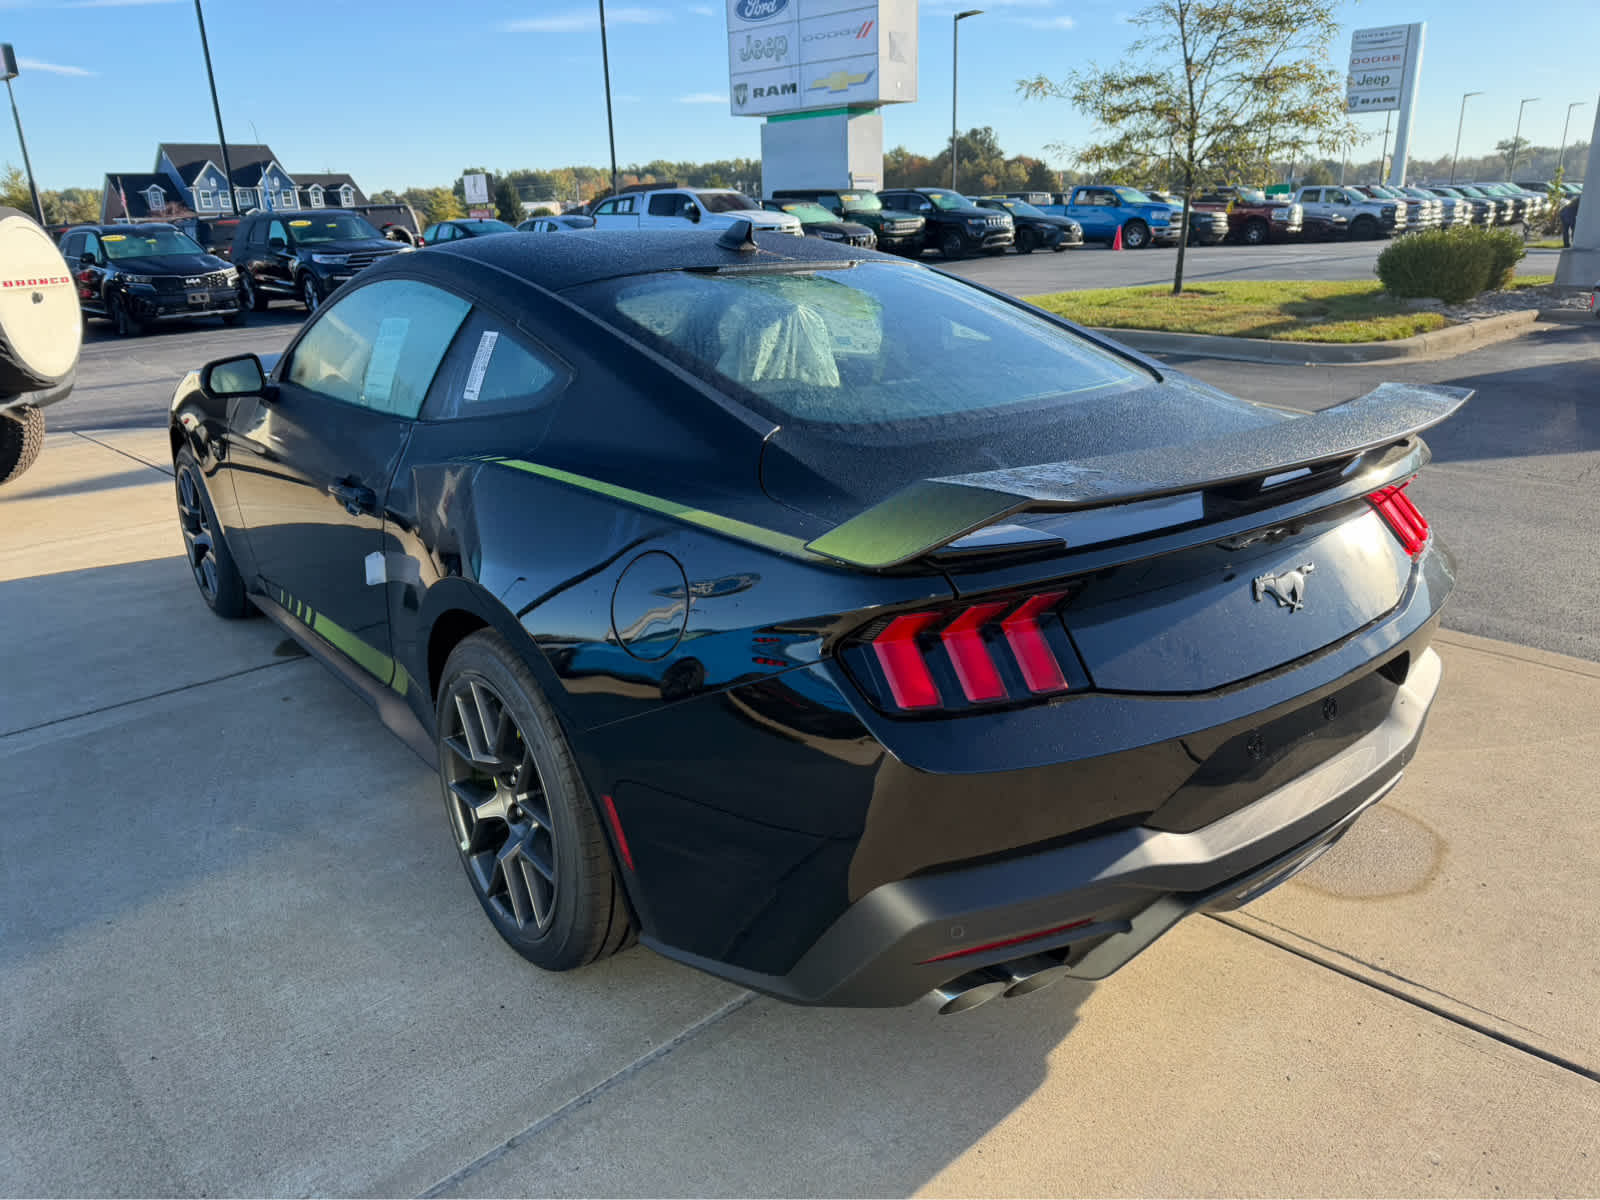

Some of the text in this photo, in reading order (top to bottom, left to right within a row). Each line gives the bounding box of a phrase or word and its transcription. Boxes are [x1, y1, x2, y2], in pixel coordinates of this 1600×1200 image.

[744, 0, 777, 17] Ford
[739, 34, 788, 62] Jeep
[1357, 73, 1390, 87] Jeep
[753, 83, 797, 98] RAM
[3, 276, 70, 287] BRONCO
